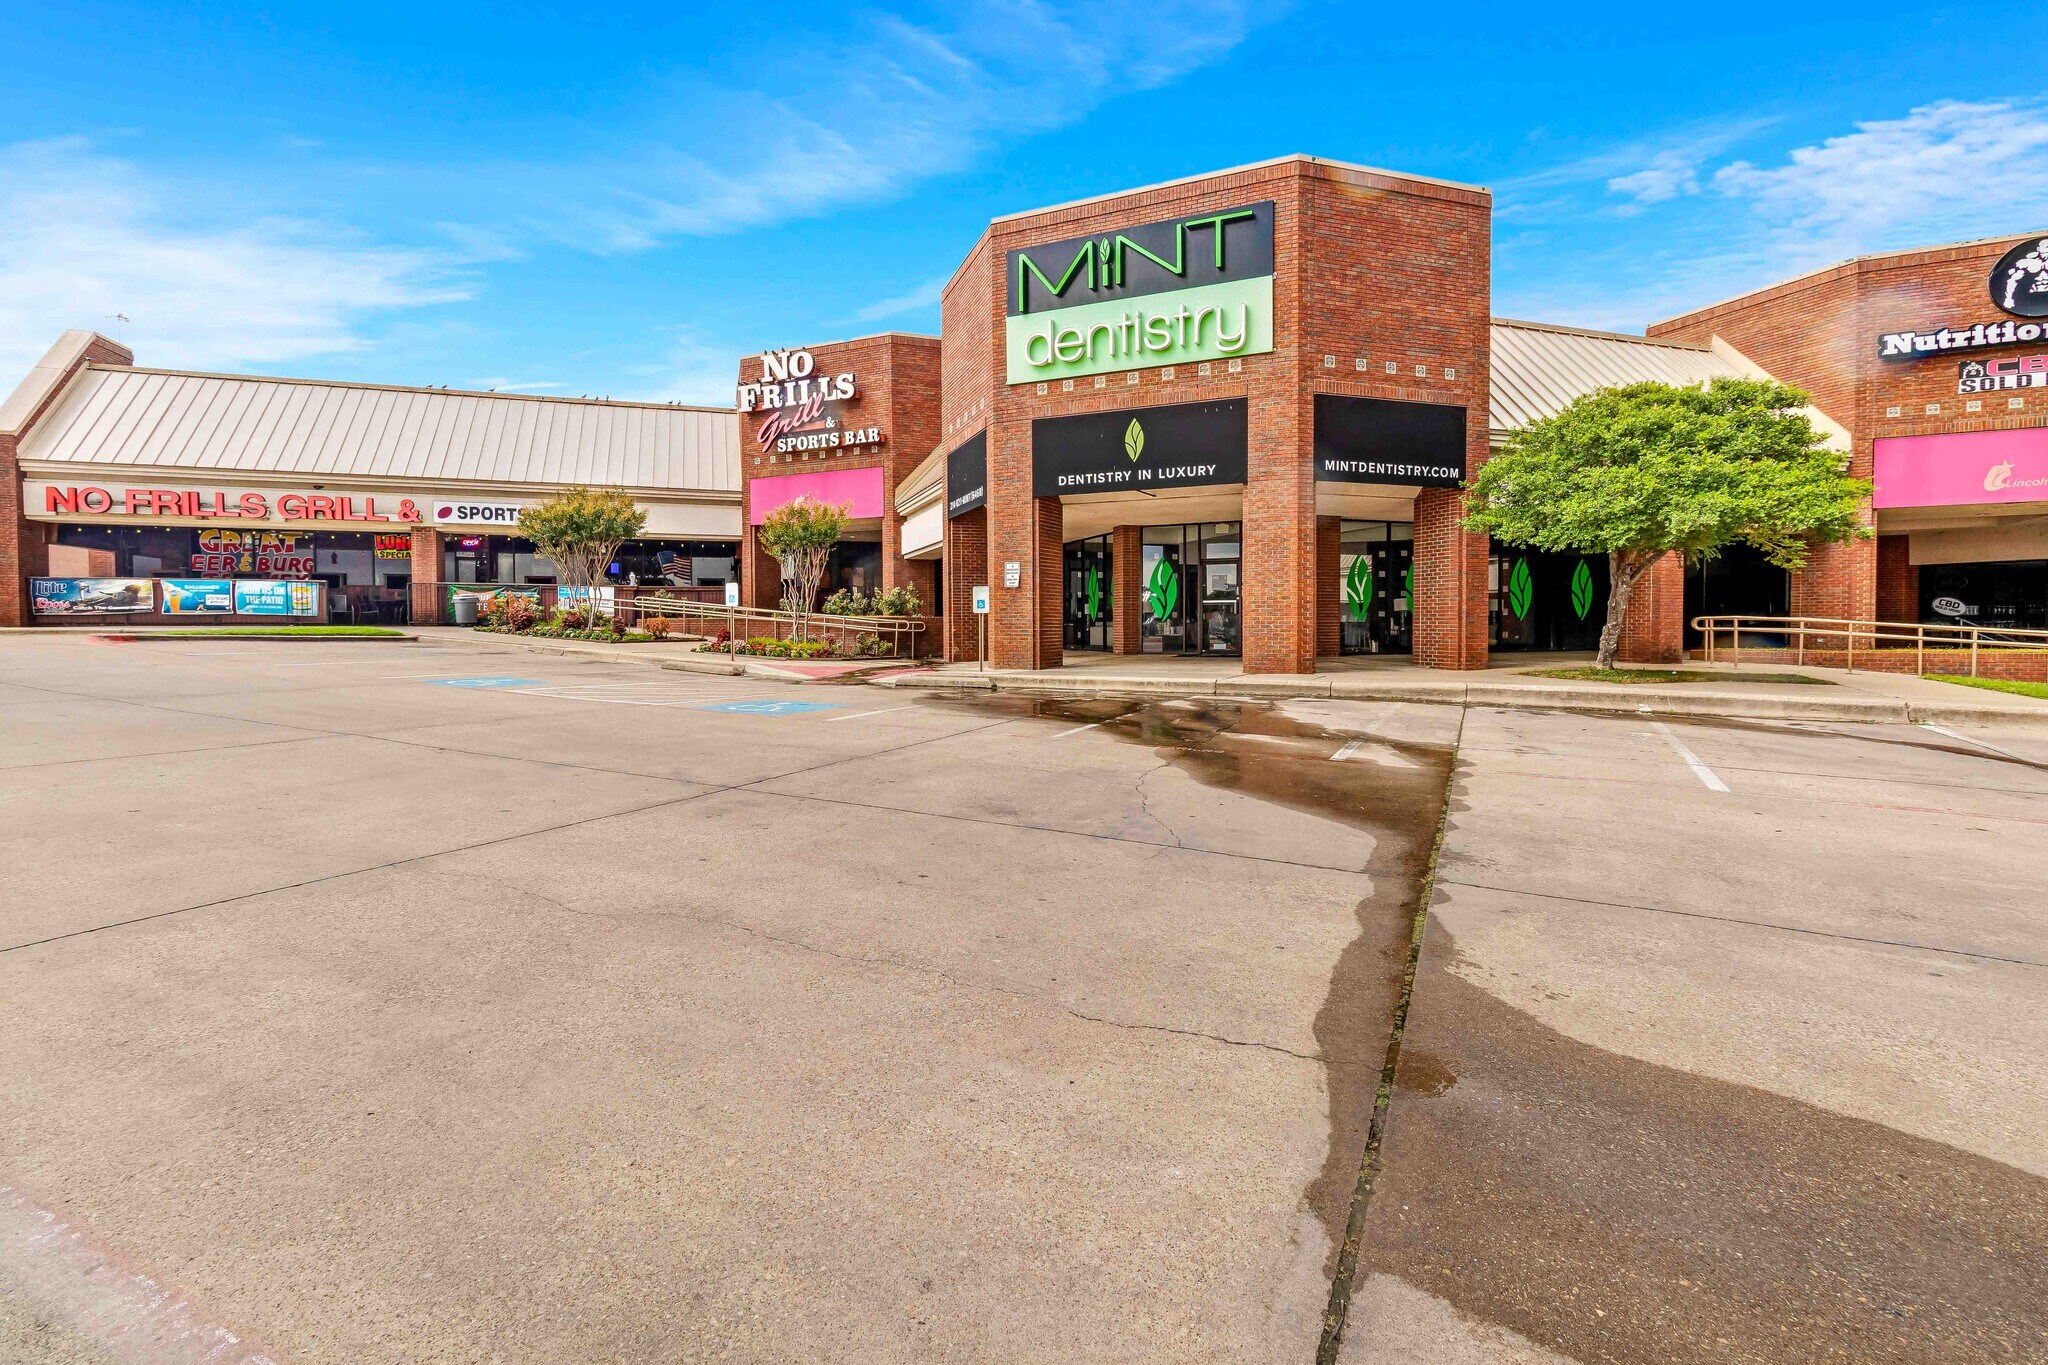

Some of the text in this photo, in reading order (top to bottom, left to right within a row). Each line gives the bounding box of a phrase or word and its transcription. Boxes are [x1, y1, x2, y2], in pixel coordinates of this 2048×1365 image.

[1024, 301, 1248, 368] dentistry
[1881, 321, 2048, 355] Nutritio
[760, 351, 814, 382] NO
[738, 373, 855, 412] FRILLS
[1961, 374, 2032, 392] SOLD
[757, 392, 825, 453] Grill
[825, 416, 836, 429] &
[777, 427, 880, 453] SPORTS BAR
[1058, 464, 1217, 486] DENTISTRY IN LUXURY
[1324, 459, 1460, 479] MINTDENTISTRY.COM
[45, 486, 422, 524] NO FRILLS GRILL &
[35, 580, 68, 597] Lite
[36, 597, 70, 609] Coors
[245, 595, 261, 605] THE
[262, 595, 284, 605] PATIO
[1938, 599, 1960, 609] CBD
